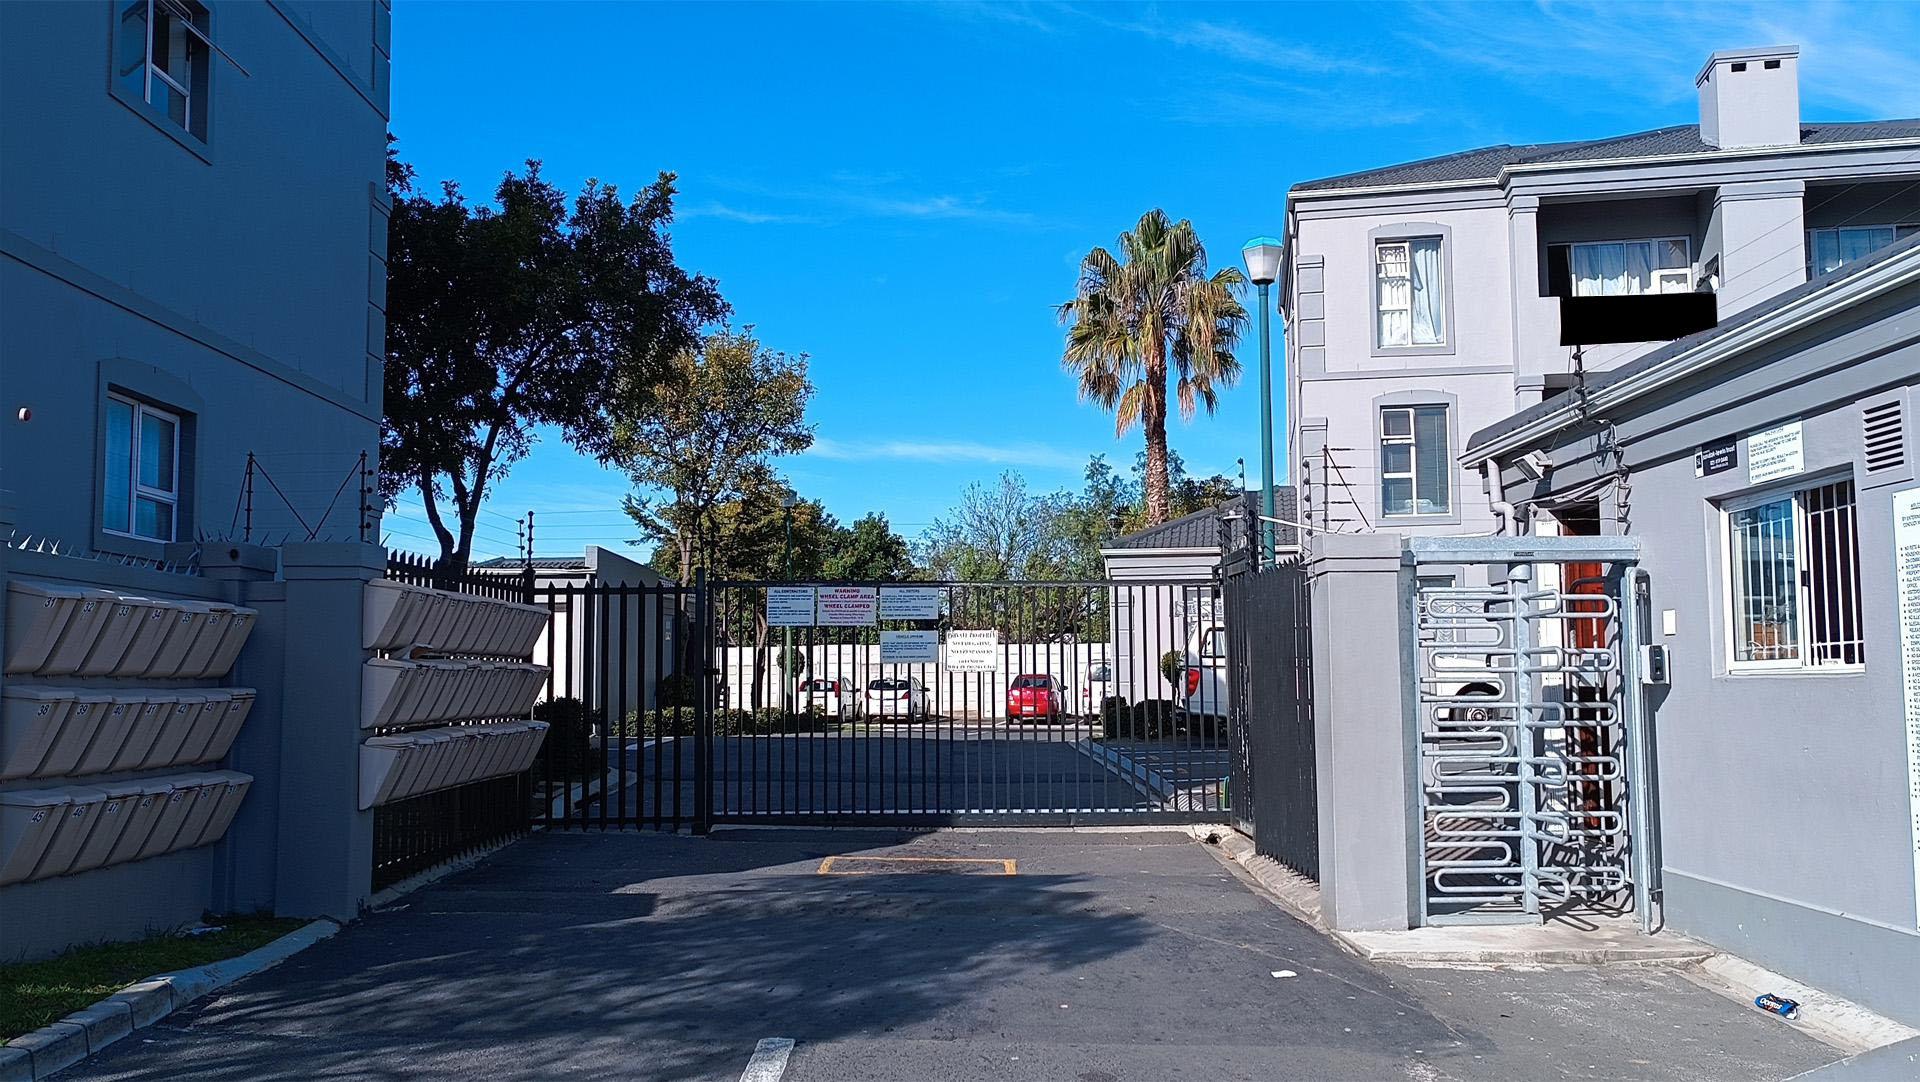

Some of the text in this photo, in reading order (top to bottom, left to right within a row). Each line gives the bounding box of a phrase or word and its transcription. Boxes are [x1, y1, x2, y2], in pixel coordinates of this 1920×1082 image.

[44, 598, 56, 608] 31
[83, 602, 94, 612] 32
[118, 606, 128, 616] 33
[151, 610, 161, 620] 34
[182, 613, 191, 623] 35
[209, 615, 218, 624] 36
[235, 617, 244, 627] 37
[38, 705, 50, 716] 38
[77, 704, 88, 715] 39
[114, 705, 124, 716] 40
[146, 705, 156, 715] 41
[177, 704, 186, 714] 42
[231, 703, 239, 712] 44
[73, 806, 84, 817] 46
[107, 802, 118, 813] 47
[32, 810, 44, 823] 45
